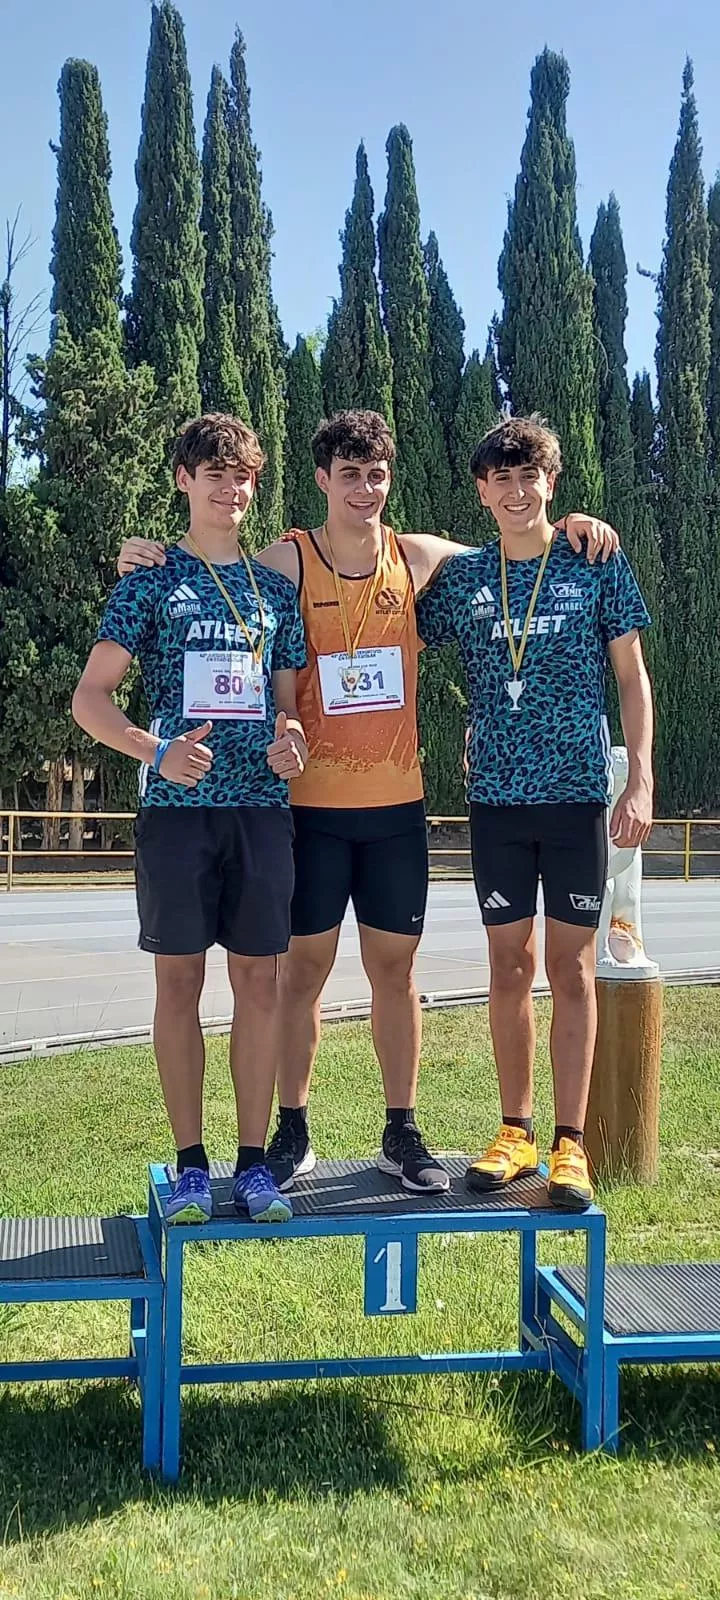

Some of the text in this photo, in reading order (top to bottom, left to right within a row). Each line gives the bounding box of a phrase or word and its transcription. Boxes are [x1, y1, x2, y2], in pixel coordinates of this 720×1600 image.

[186, 620, 261, 643] ATLEET
[490, 615, 566, 640] ATLEET
[214, 674, 244, 695] 80
[374, 1241, 407, 1311] 1
